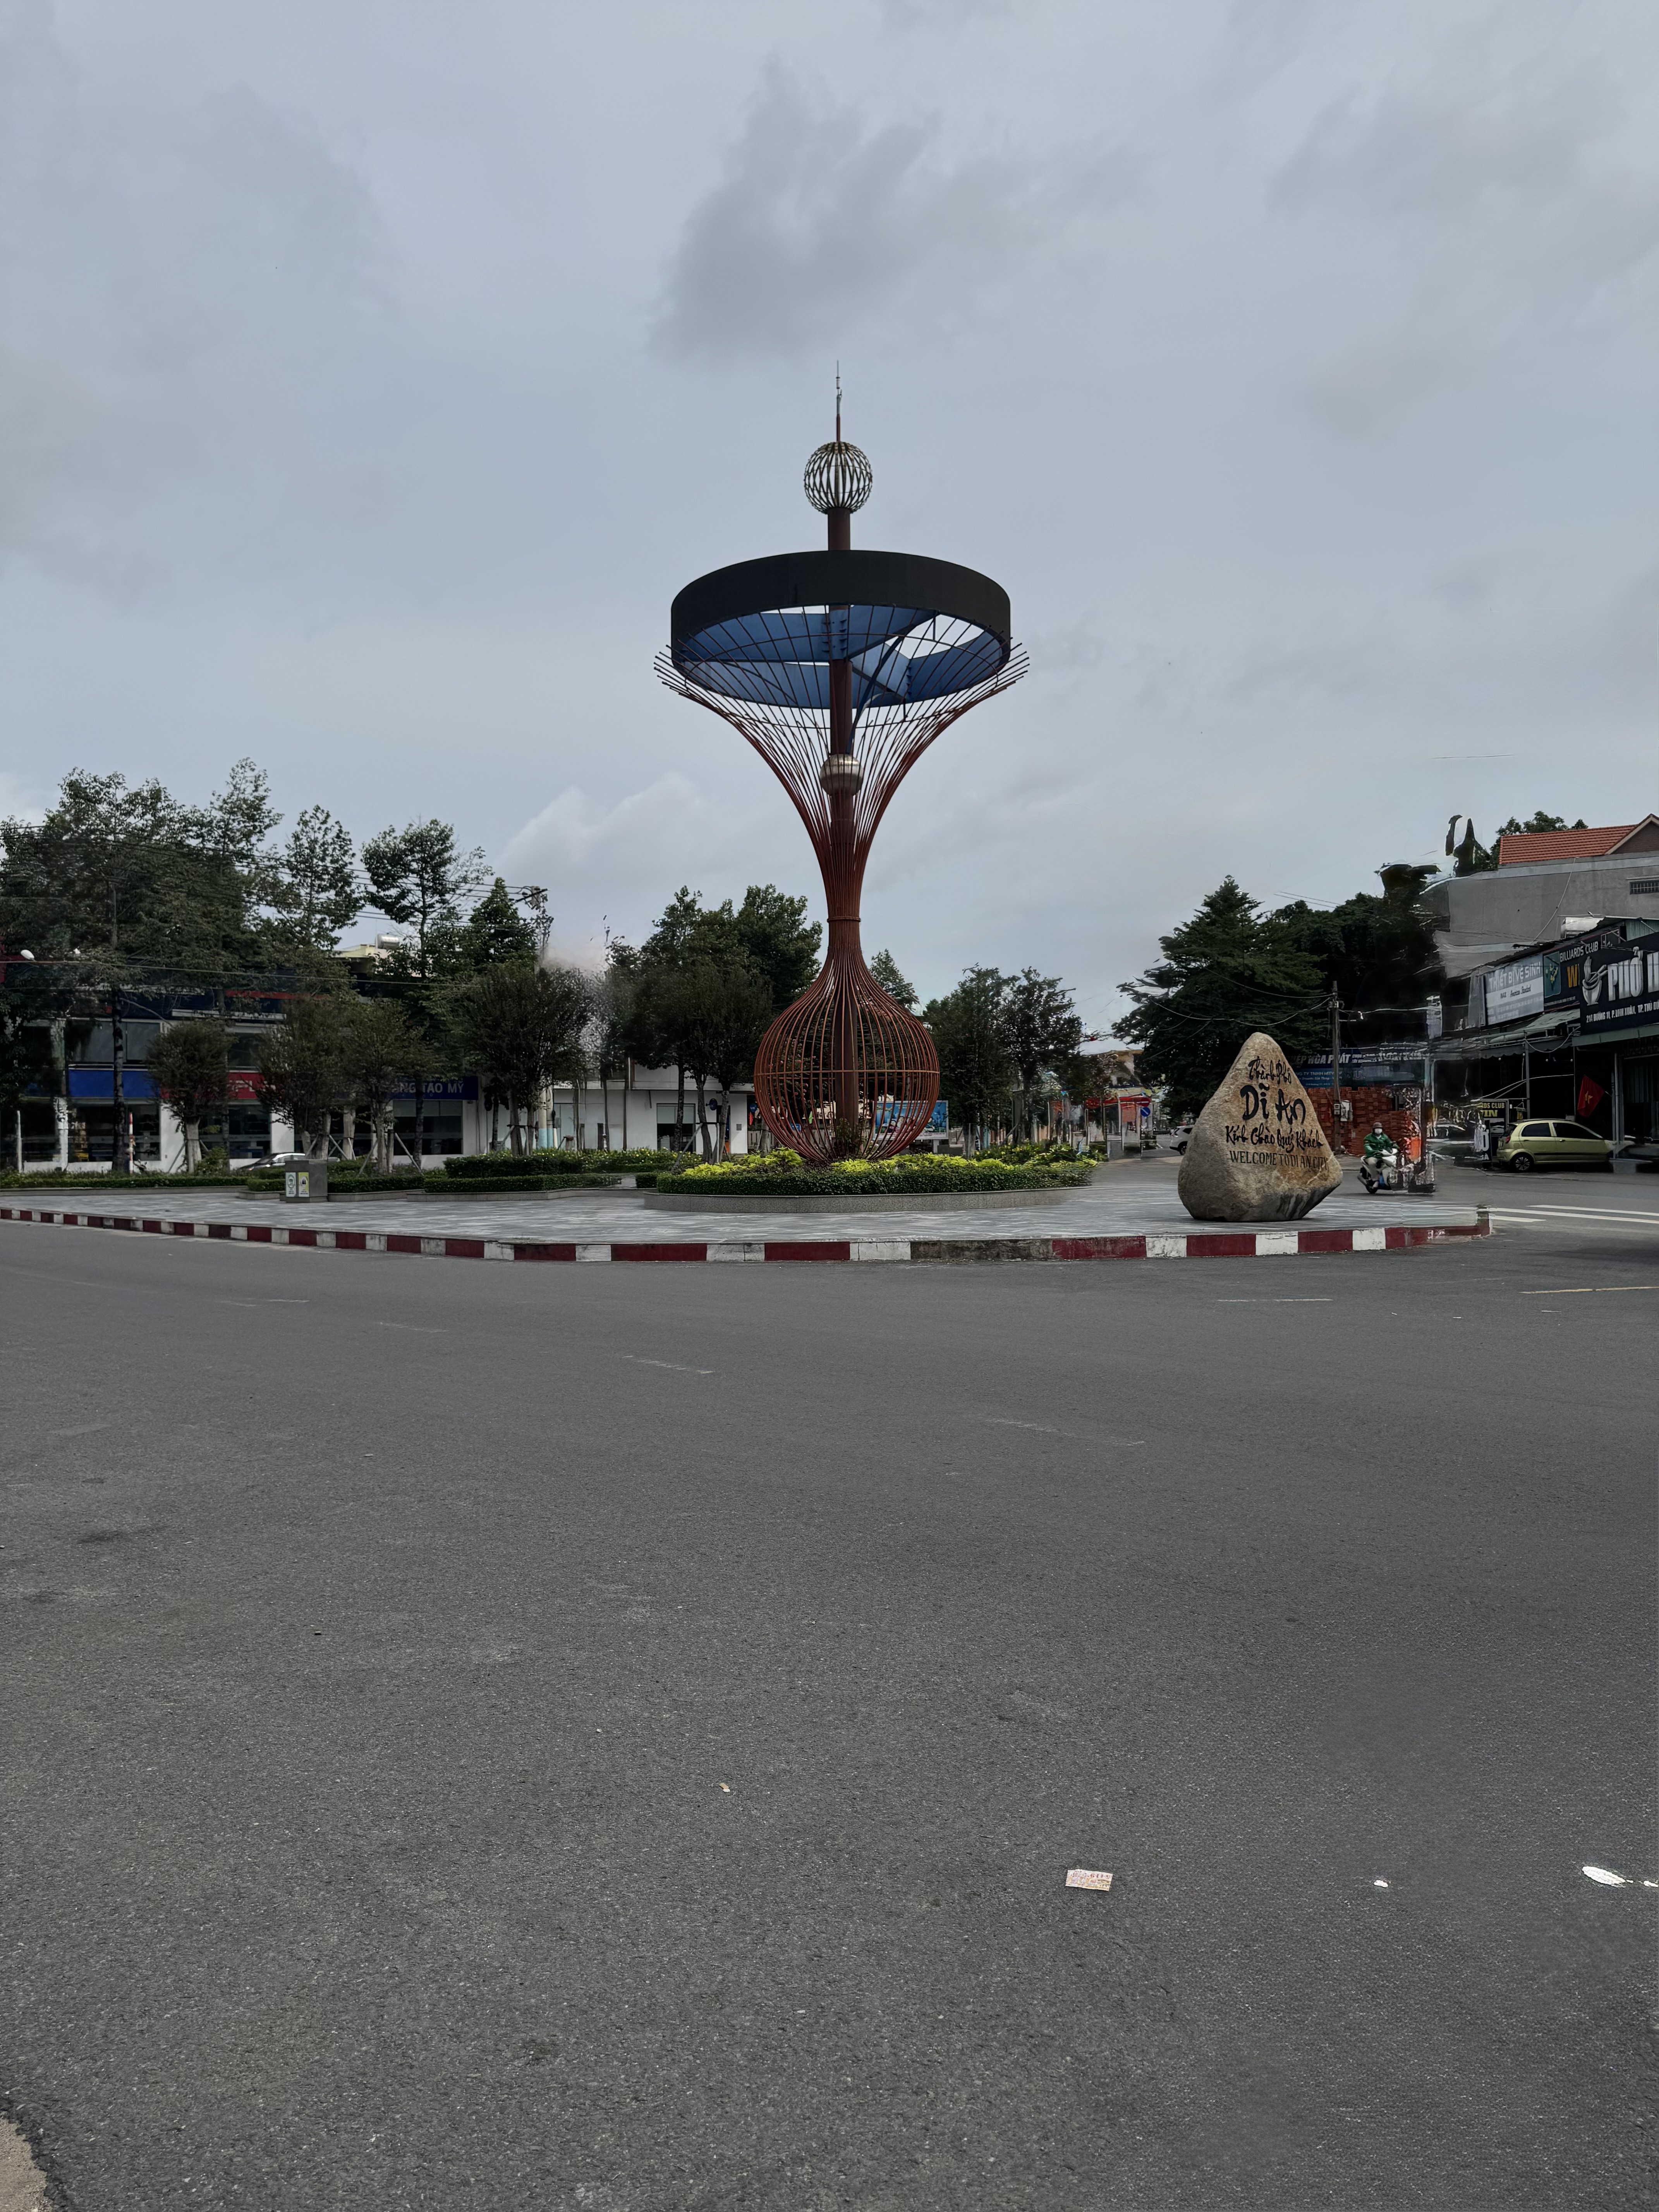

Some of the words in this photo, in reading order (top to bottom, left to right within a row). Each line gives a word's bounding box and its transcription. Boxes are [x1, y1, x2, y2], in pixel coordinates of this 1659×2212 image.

[1560, 946, 1584, 963] BILLIARDS
[1585, 941, 1599, 955] CLUB
[1489, 968, 1507, 991] THIẾT
[1525, 961, 1541, 979] SINH
[1607, 946, 1644, 1001] PHỞ
[1240, 1083, 1270, 1120] Dĩ
[1275, 1088, 1306, 1125] An
[1225, 1124, 1249, 1145] Kính
[1250, 1123, 1275, 1146] Chào
[1295, 1129, 1324, 1151] Khách
[1229, 1150, 1277, 1166] WELCOME
[1278, 1153, 1290, 1166] TO
